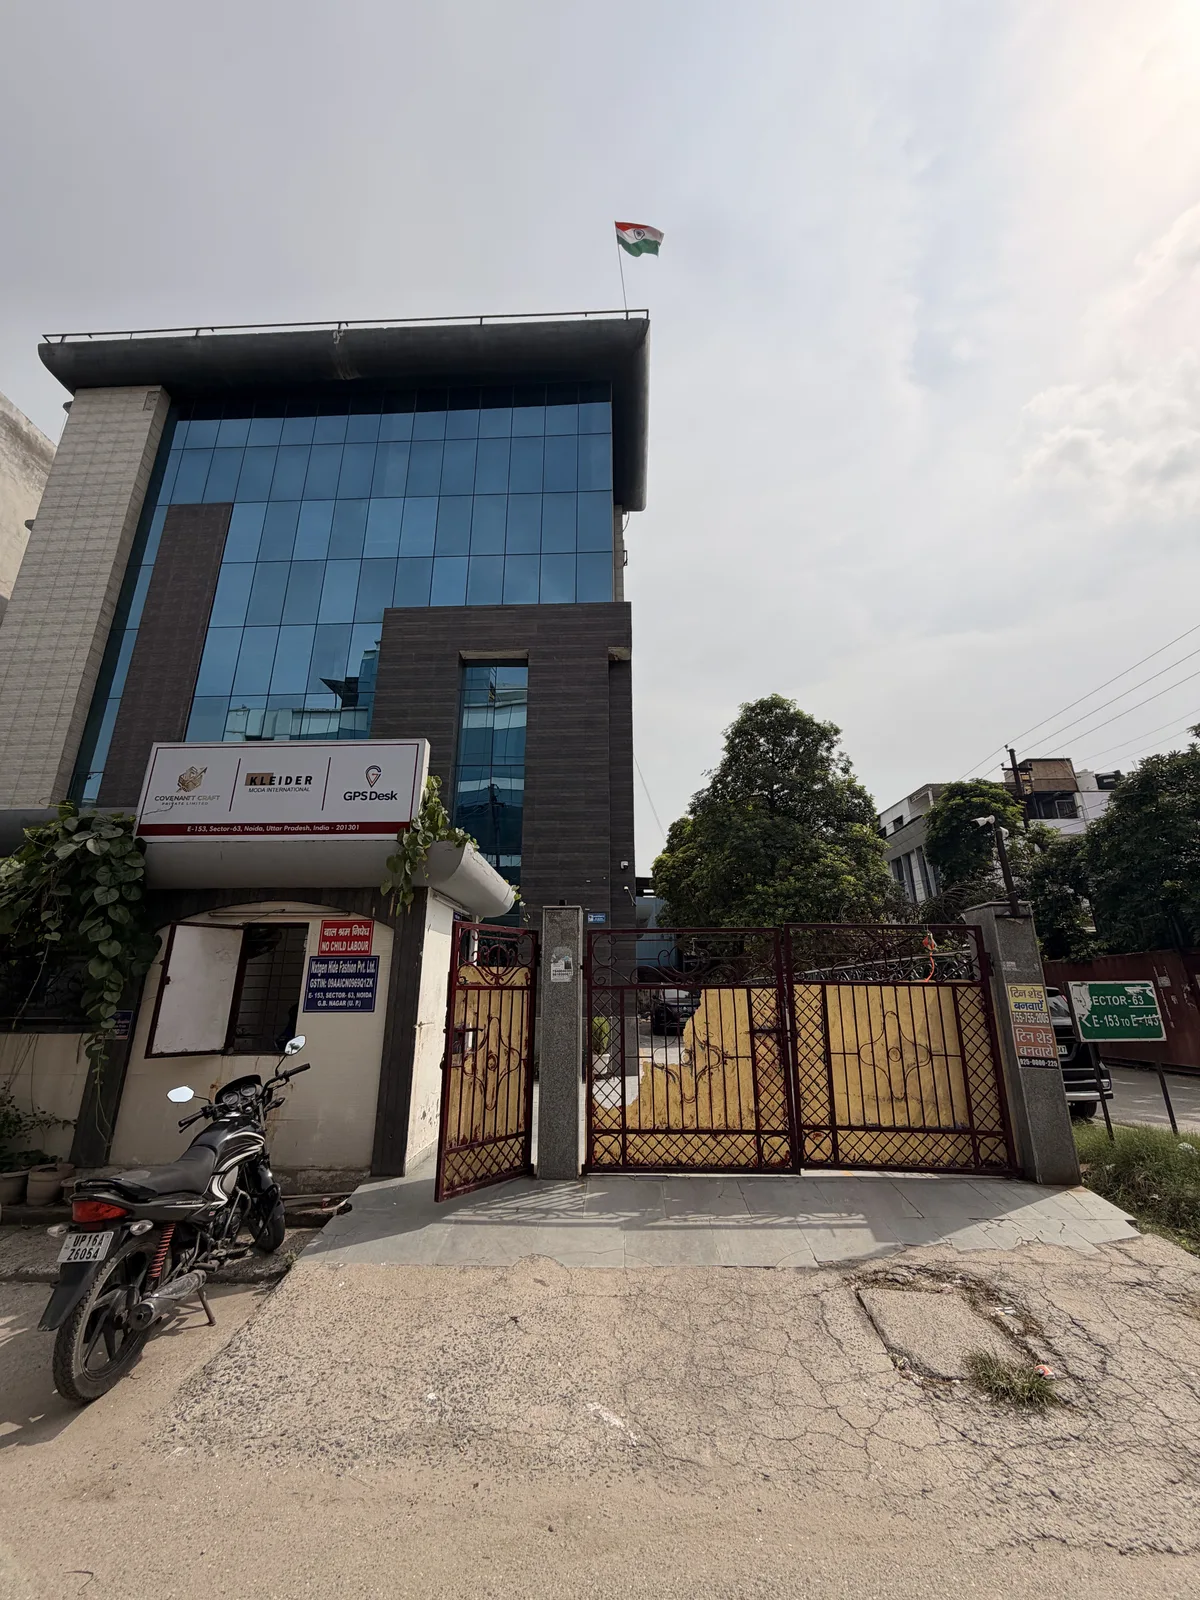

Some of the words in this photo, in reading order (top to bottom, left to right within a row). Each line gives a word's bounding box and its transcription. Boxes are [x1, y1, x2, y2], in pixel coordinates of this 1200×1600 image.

[249, 776, 313, 786] KLEIDER
[209, 825, 243, 833] Sector-63,
[244, 825, 265, 833] Noida,
[283, 824, 312, 832] Pradesh,
[324, 928, 337, 937] बाल
[338, 928, 351, 937] श्रम
[321, 942, 330, 951] NO
[330, 942, 347, 951] CHILD
[347, 941, 369, 951] LABOUR
[339, 961, 356, 973] Fashion
[310, 979, 327, 988] GSTIN:
[1010, 986, 1027, 998] टिन
[1028, 987, 1043, 999] शेड
[1092, 995, 1144, 1006] ECTOR-63
[1015, 1028, 1034, 1043] टिन
[1036, 1029, 1053, 1044] शेड
[67, 1247, 101, 1261] Z6054
